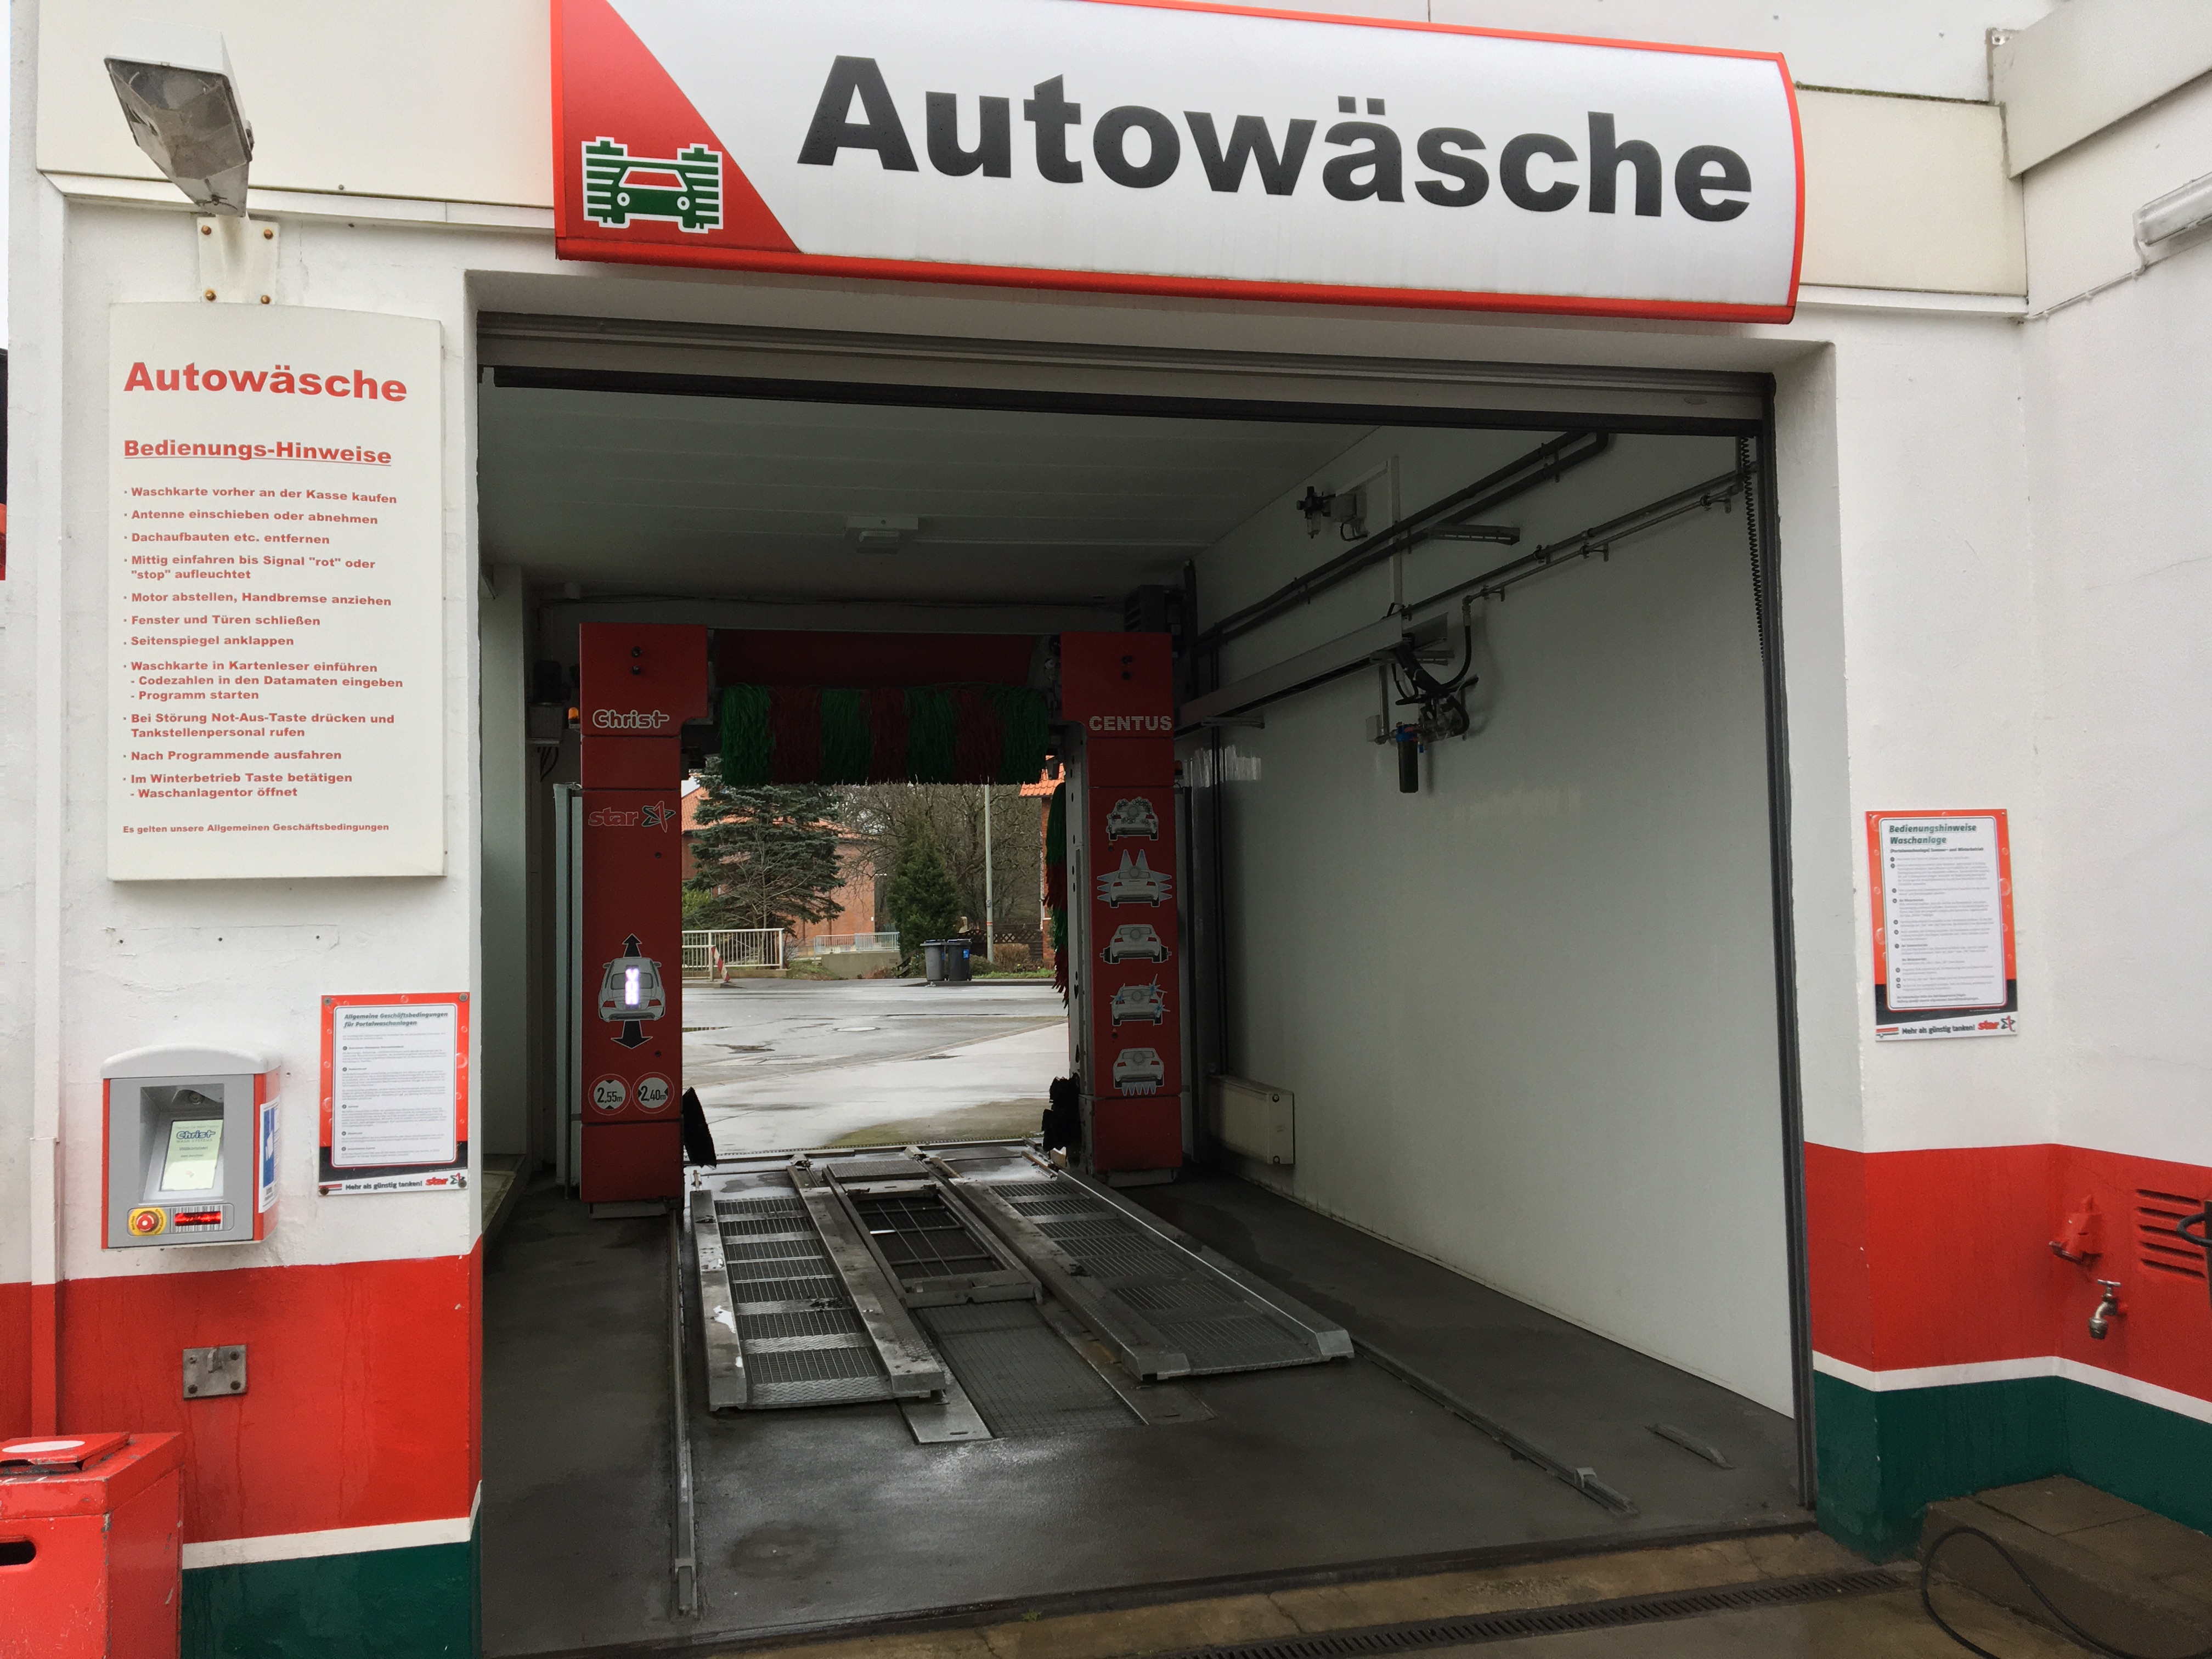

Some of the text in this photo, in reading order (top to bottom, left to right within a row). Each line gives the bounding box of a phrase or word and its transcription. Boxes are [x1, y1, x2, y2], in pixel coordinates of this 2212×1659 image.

[797, 58, 1751, 222] Autowäsche
[123, 360, 408, 403] Autowäsche
[123, 438, 392, 465] Bedienungs-Hinweise
[130, 486, 398, 505] Waschkarte vorher an der Kasse kaufen
[131, 509, 379, 525] Antenne einschieben oder abnehmen
[130, 532, 330, 545] Dachaufbauten etc. entfernen
[131, 554, 375, 569] Mittig einfahren bis Signal "rot" oder
[131, 568, 251, 582] "stop" aufleuchtet
[131, 591, 392, 607] Motor abstellen, Handbremse anziehen
[129, 614, 321, 627] Fenster und Türen schließen
[130, 635, 295, 648] Seitenspiegel anklappen
[130, 661, 378, 673] Waschkarte in Kartenleser einführen
[137, 675, 404, 690] Codezahlen in den Datamaten eingeben
[137, 690, 260, 703] Programm starten
[130, 712, 395, 725] Bei Störung Not-Aus-Taste drücken und
[592, 709, 670, 729] Christ
[1089, 716, 1173, 731] CENTUS
[131, 726, 306, 740] Tankstellenpersonal rufen
[130, 749, 342, 763] Nach Programmende ausfahren
[130, 772, 353, 785] Im Winterbetrieb Taste betätigen
[137, 787, 298, 800] Waschanlagentor öffnet
[588, 806, 639, 827] star
[122, 825, 134, 834] Es
[136, 825, 168, 835] gelten
[206, 824, 270, 834] Allgemeinen
[272, 823, 390, 833] Geschäftsbedingungen
[1889, 823, 1977, 833] Bedienungshinweise
[1890, 836, 1946, 845] Waschanlage
[1929, 1026, 1951, 1034] günstig
[1977, 1020, 2000, 1030] star
[597, 1087, 623, 1103] 2,55m
[640, 1085, 666, 1102] 2,40m
[176, 1130, 216, 1139] Christ
[373, 1182, 397, 1190] günstig
[425, 1177, 449, 1186] star
